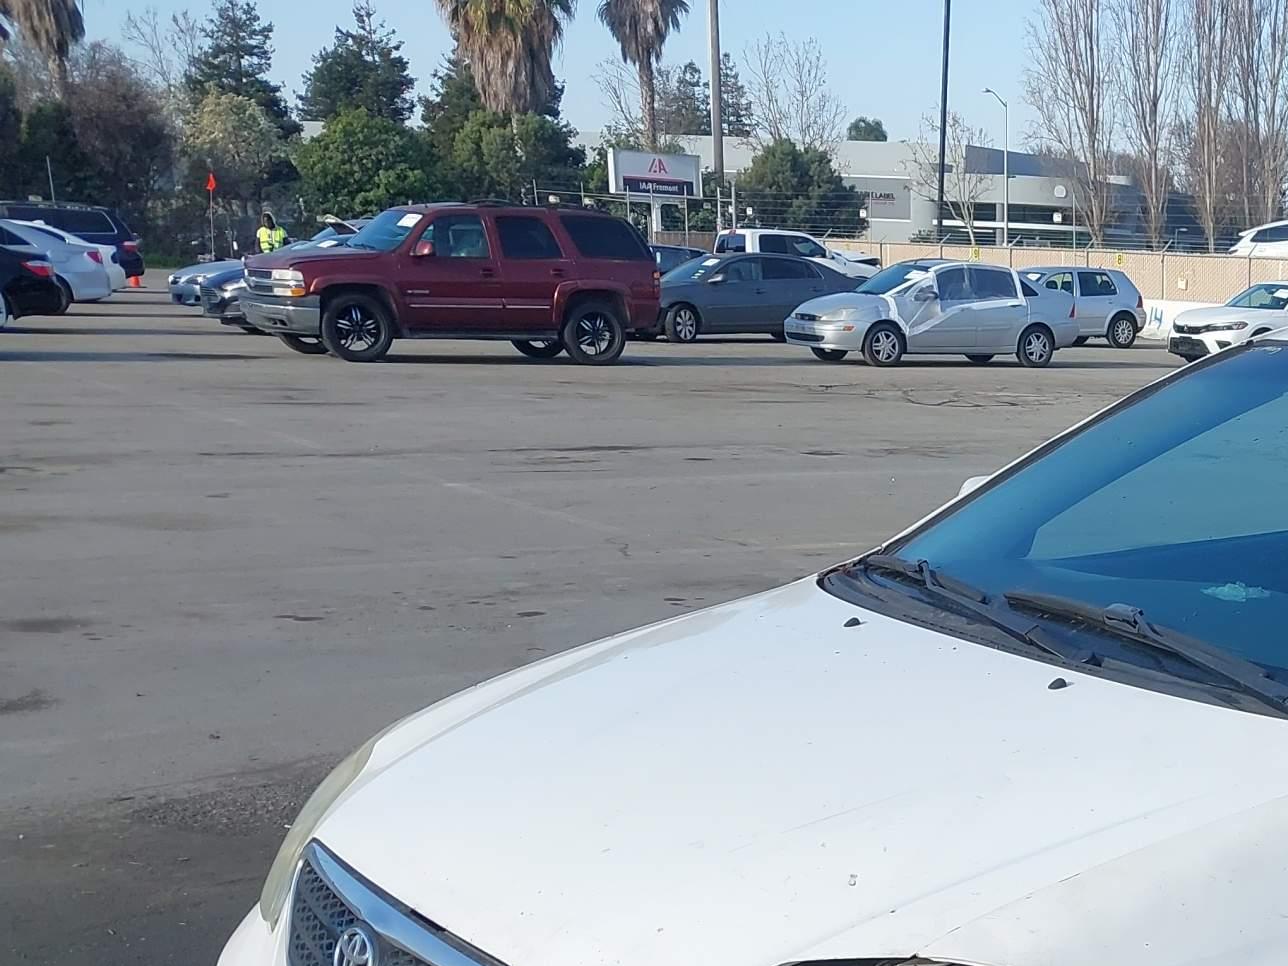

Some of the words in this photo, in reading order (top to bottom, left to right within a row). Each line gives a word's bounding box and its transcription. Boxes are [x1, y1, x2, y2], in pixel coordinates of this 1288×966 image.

[639, 181, 652, 190] IAA
[652, 182, 679, 193] Fremont
[1148, 306, 1164, 331] 14
